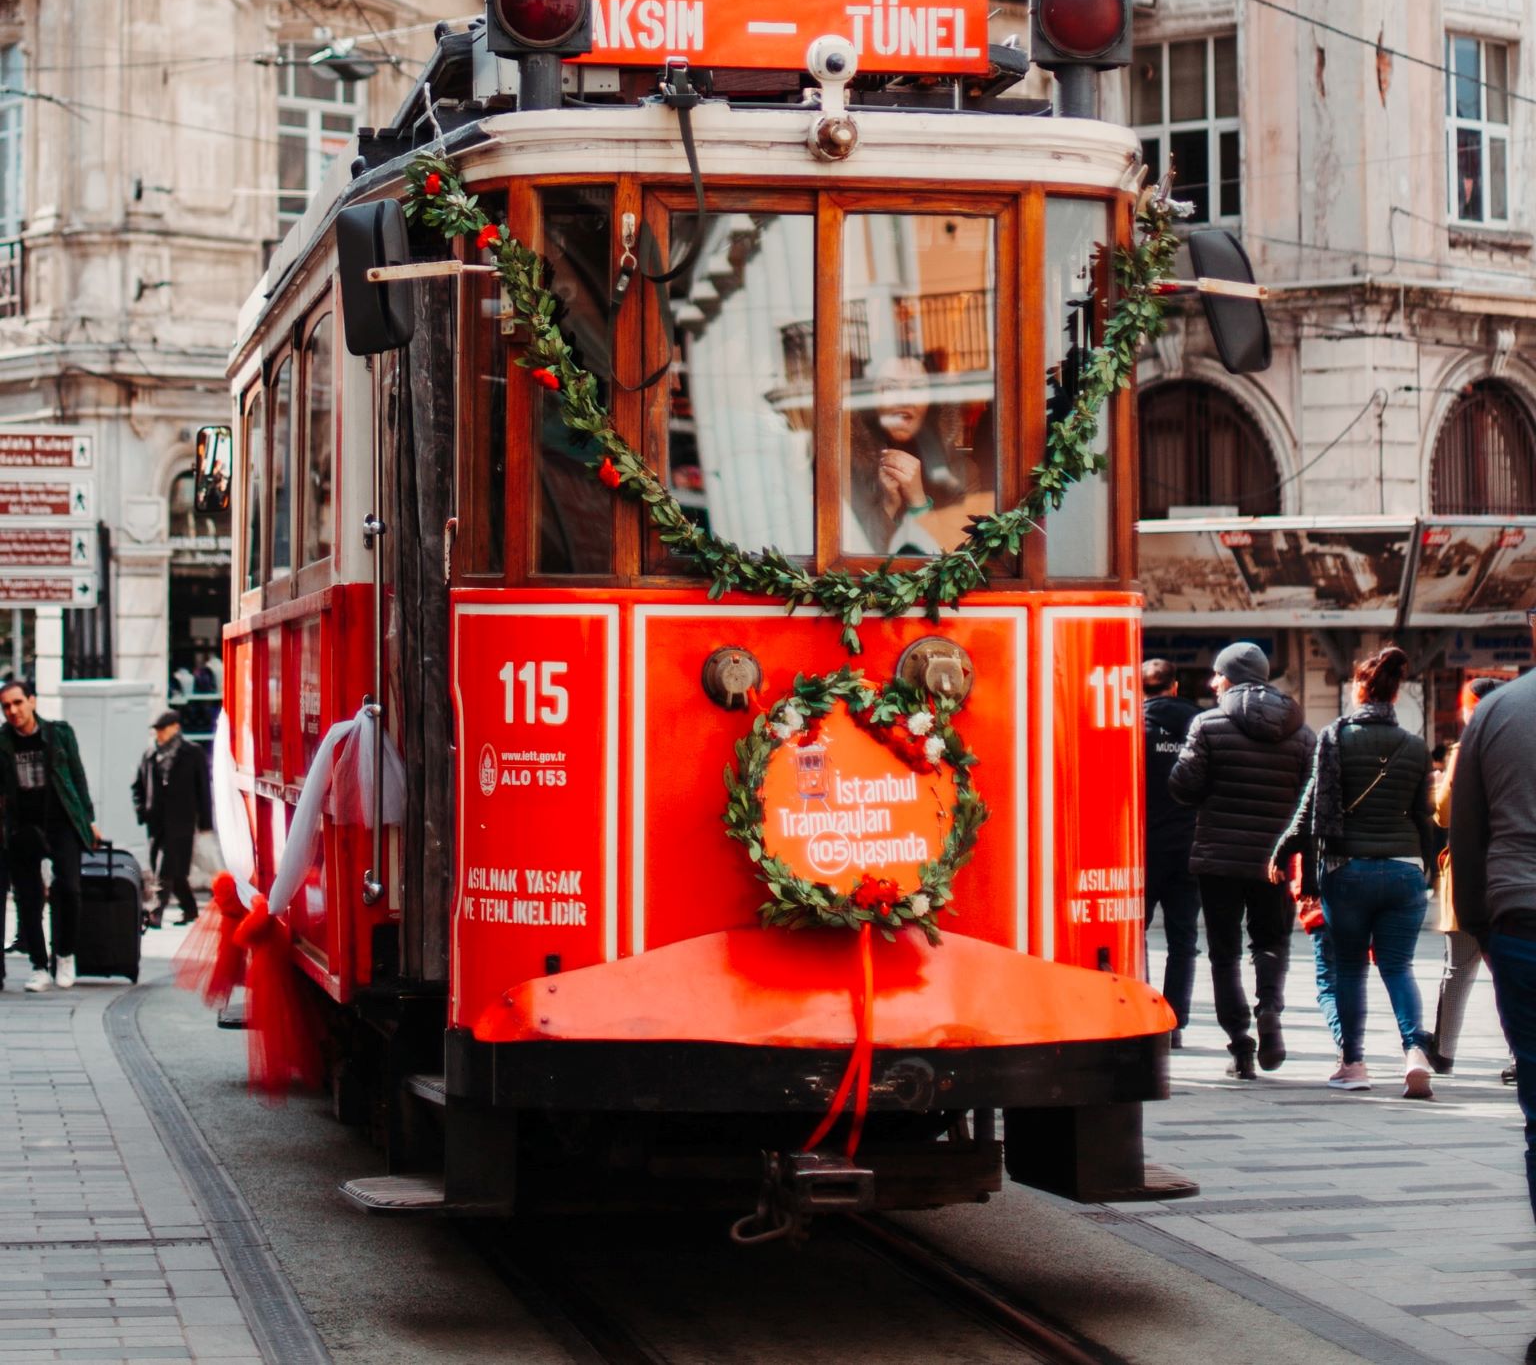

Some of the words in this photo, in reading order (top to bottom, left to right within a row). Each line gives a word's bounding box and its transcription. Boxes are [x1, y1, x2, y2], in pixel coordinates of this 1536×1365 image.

[499, 661, 569, 725] 115
[1089, 666, 1136, 728] 115
[500, 769, 532, 786] ALO
[536, 769, 567, 787] 153
[835, 769, 918, 805] İstanbul
[778, 803, 892, 840] Tramvayları
[811, 839, 850, 863] 105
[852, 832, 929, 870] yaşında
[468, 866, 519, 893] ASILMAK
[525, 869, 583, 895] YASAK
[1078, 868, 1130, 892] ASILMAK
[464, 896, 476, 921] VE
[479, 897, 587, 927] TEHLİKELİDİR
[1071, 899, 1092, 924] VE
